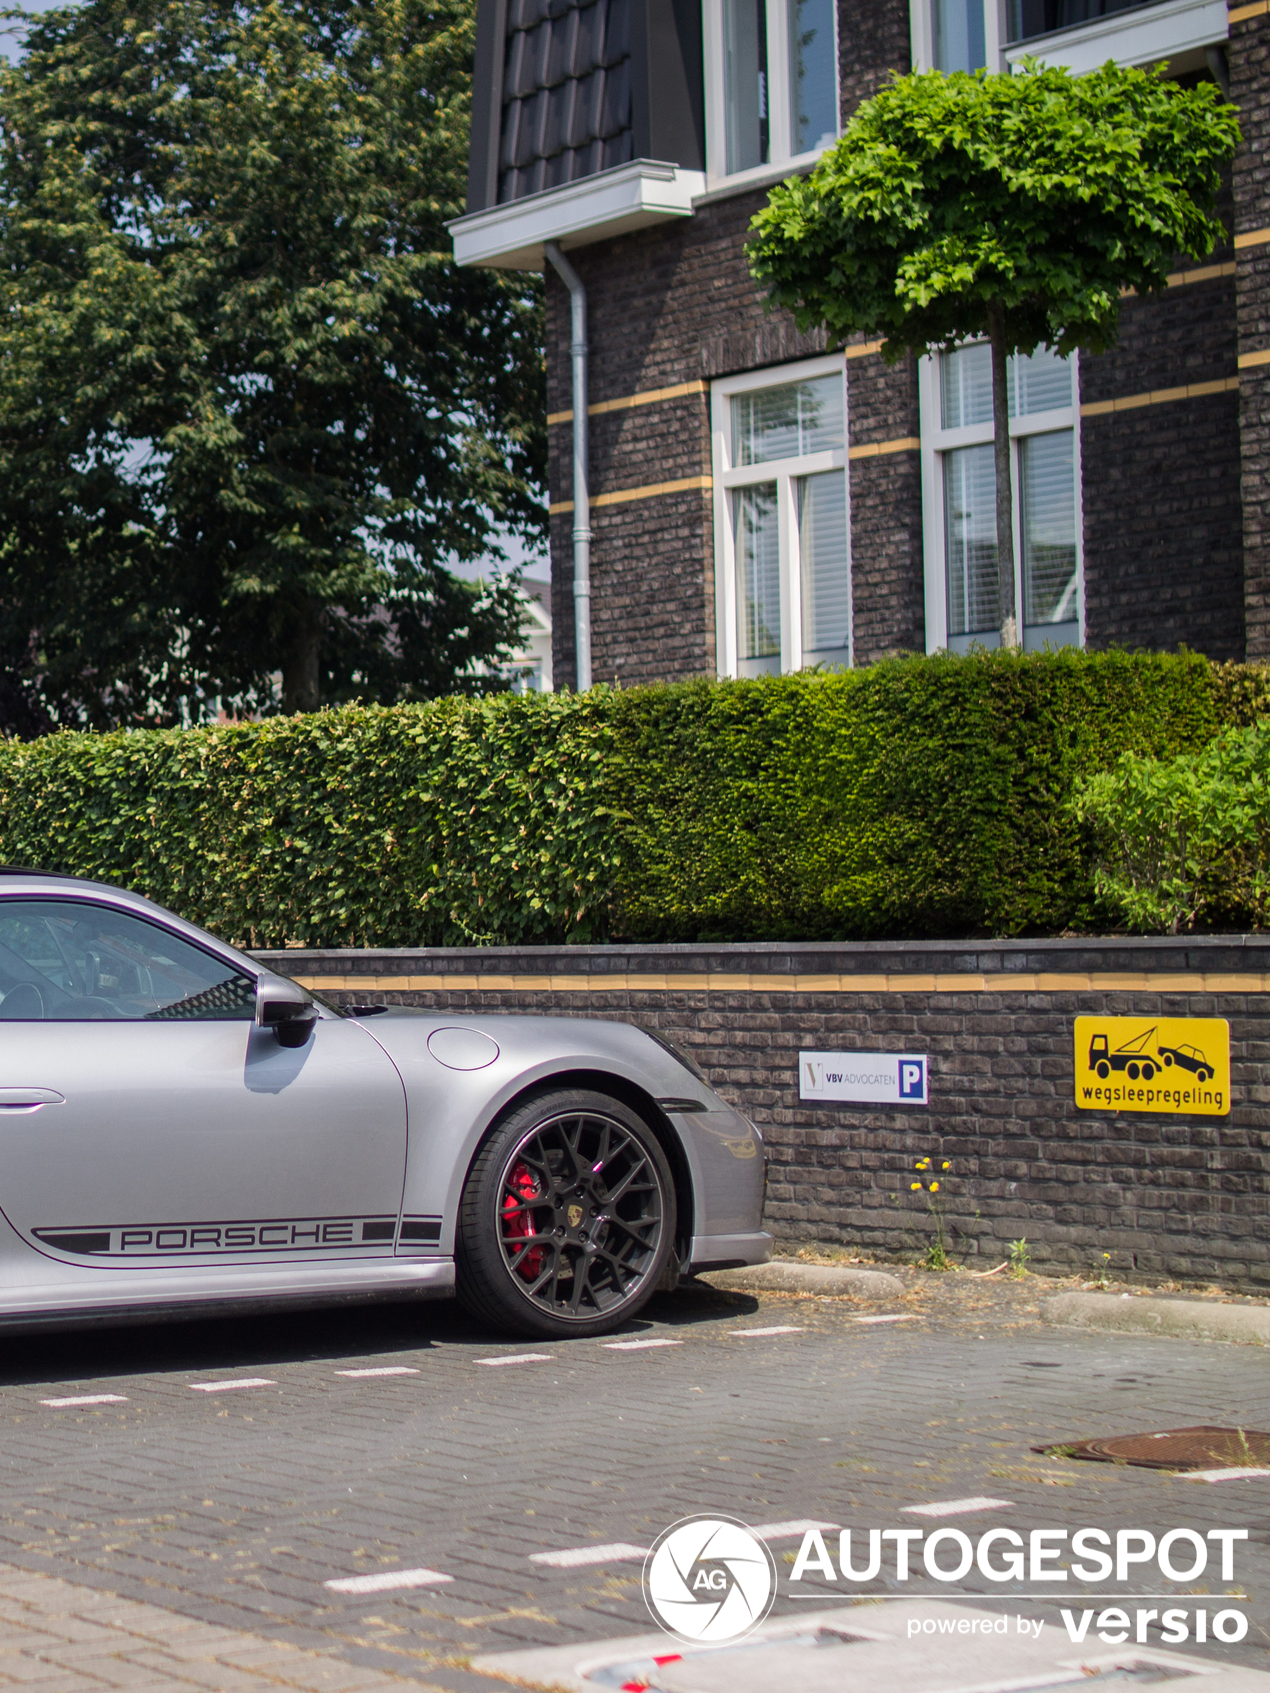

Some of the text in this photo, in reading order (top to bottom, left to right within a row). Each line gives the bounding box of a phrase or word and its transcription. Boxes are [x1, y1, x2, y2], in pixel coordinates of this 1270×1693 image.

[826, 1073, 895, 1085] VBV ADVOCATEN
[902, 1064, 920, 1093] P
[1082, 1085, 1223, 1110] wegsleepregeling
[120, 1222, 354, 1251] PORSCHE
